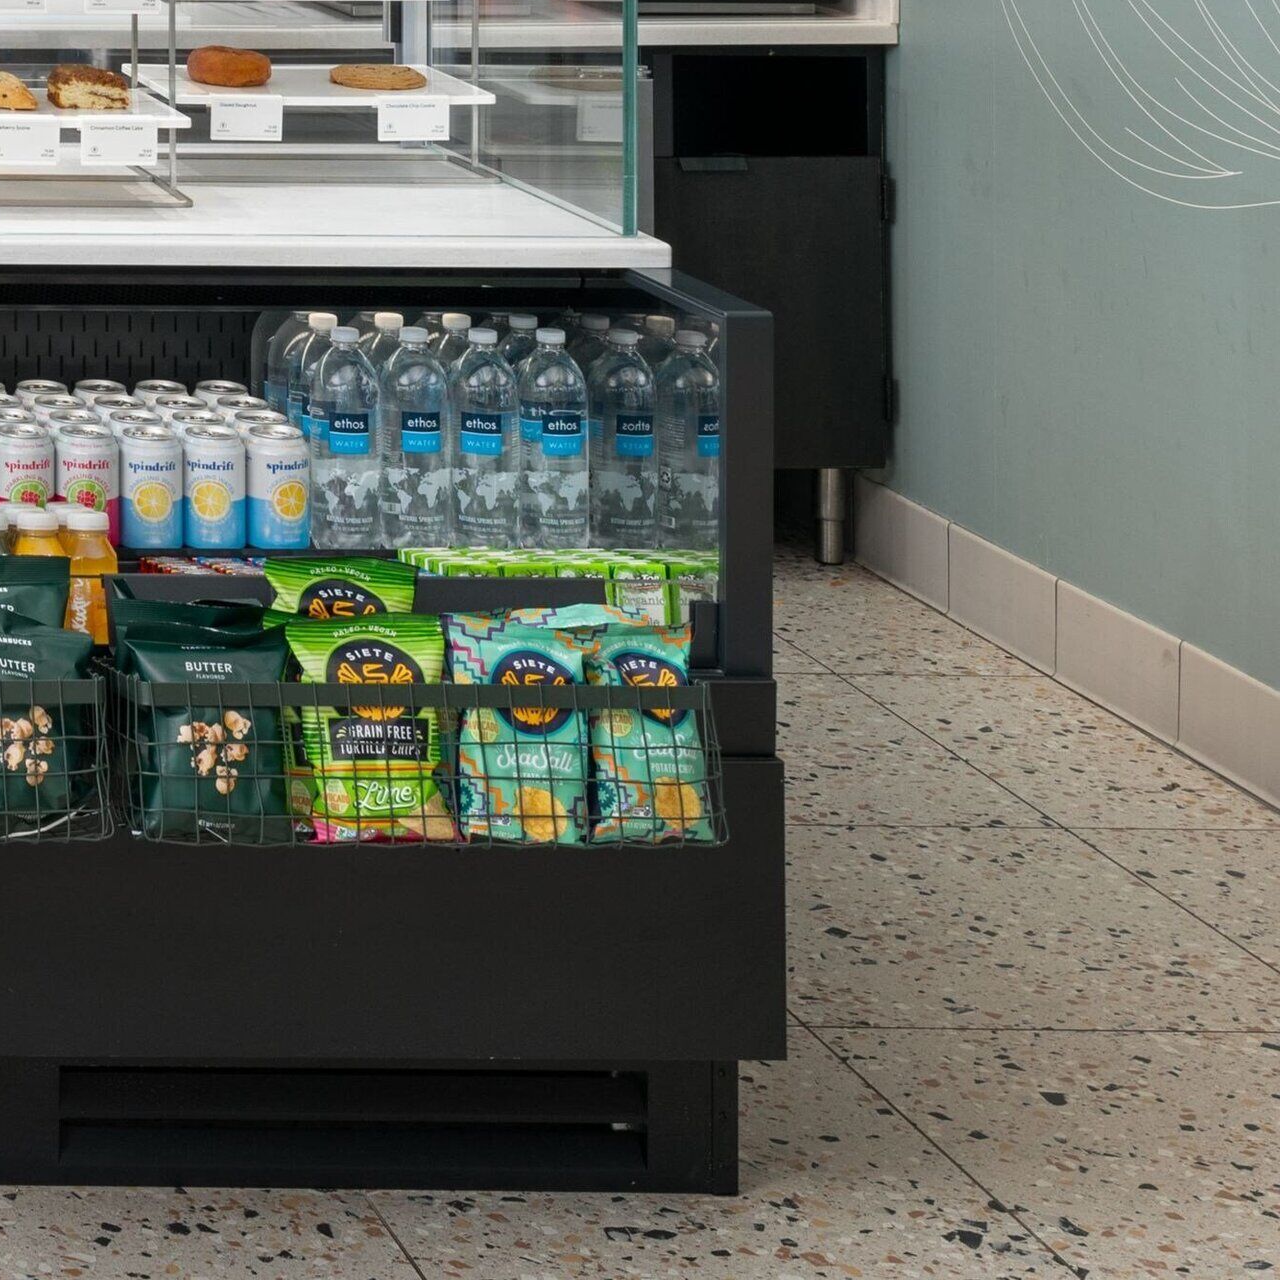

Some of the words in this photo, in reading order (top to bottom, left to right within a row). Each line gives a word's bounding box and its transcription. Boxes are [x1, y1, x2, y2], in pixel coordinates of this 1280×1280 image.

[334, 418, 364, 430] ethos
[408, 418, 436, 428] ethos
[466, 418, 497, 430] ethos
[548, 420, 577, 432] ethos
[334, 440, 365, 448] WATER
[5, 459, 51, 472] spindrift
[62, 459, 110, 472] spindrift
[128, 461, 176, 473] spindrift
[186, 460, 234, 472] spindrift
[318, 588, 366, 603] SIETE
[332, 626, 360, 638] PALEO
[368, 624, 397, 638] VEGAN
[346, 647, 394, 662] SIETE
[185, 661, 233, 674] BUTTER
[513, 659, 556, 674] SIETE
[356, 780, 416, 810] Lime
